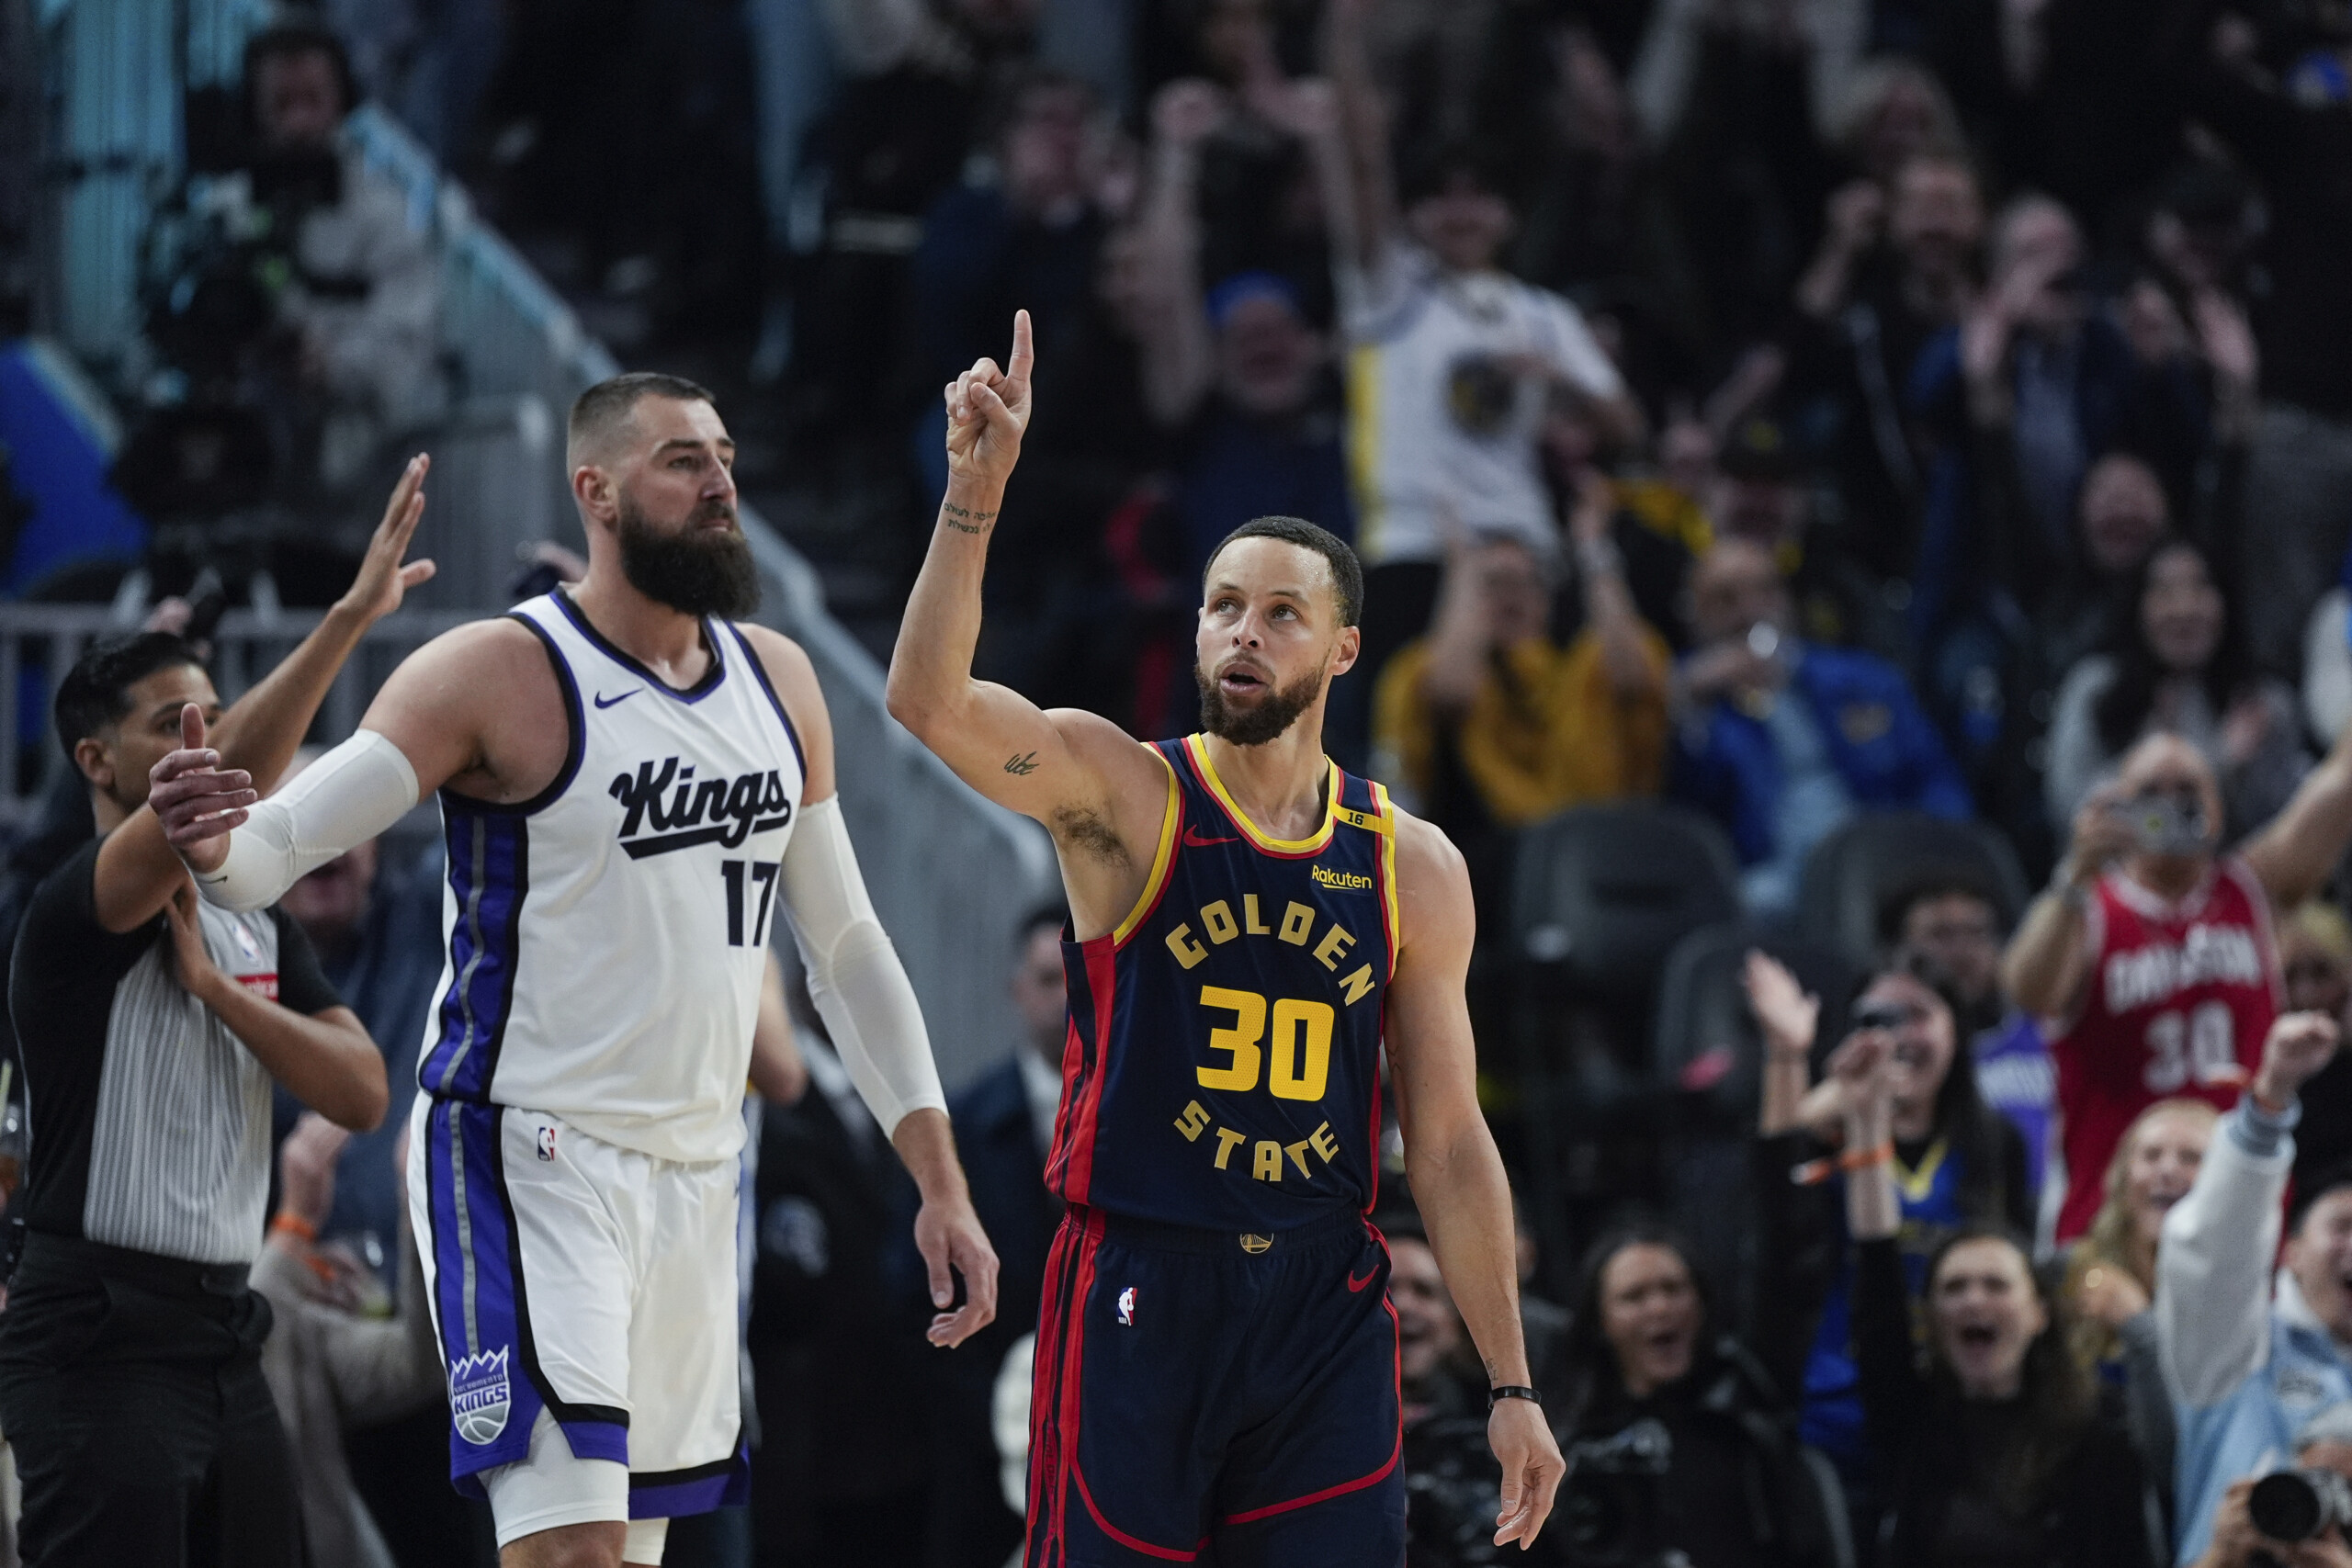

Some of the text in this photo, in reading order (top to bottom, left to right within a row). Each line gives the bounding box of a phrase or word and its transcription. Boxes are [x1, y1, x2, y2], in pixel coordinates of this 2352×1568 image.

[608, 756, 791, 852] Kings
[1348, 812, 1364, 826] 16
[721, 860, 780, 947] 17
[1312, 864, 1373, 889] Rakuten
[1165, 894, 1375, 1006] GOLDEN
[1196, 985, 1334, 1101] 30
[2143, 999, 2234, 1091] 30
[1173, 1100, 1339, 1181] STATE
[454, 1384, 508, 1416] KINGS
